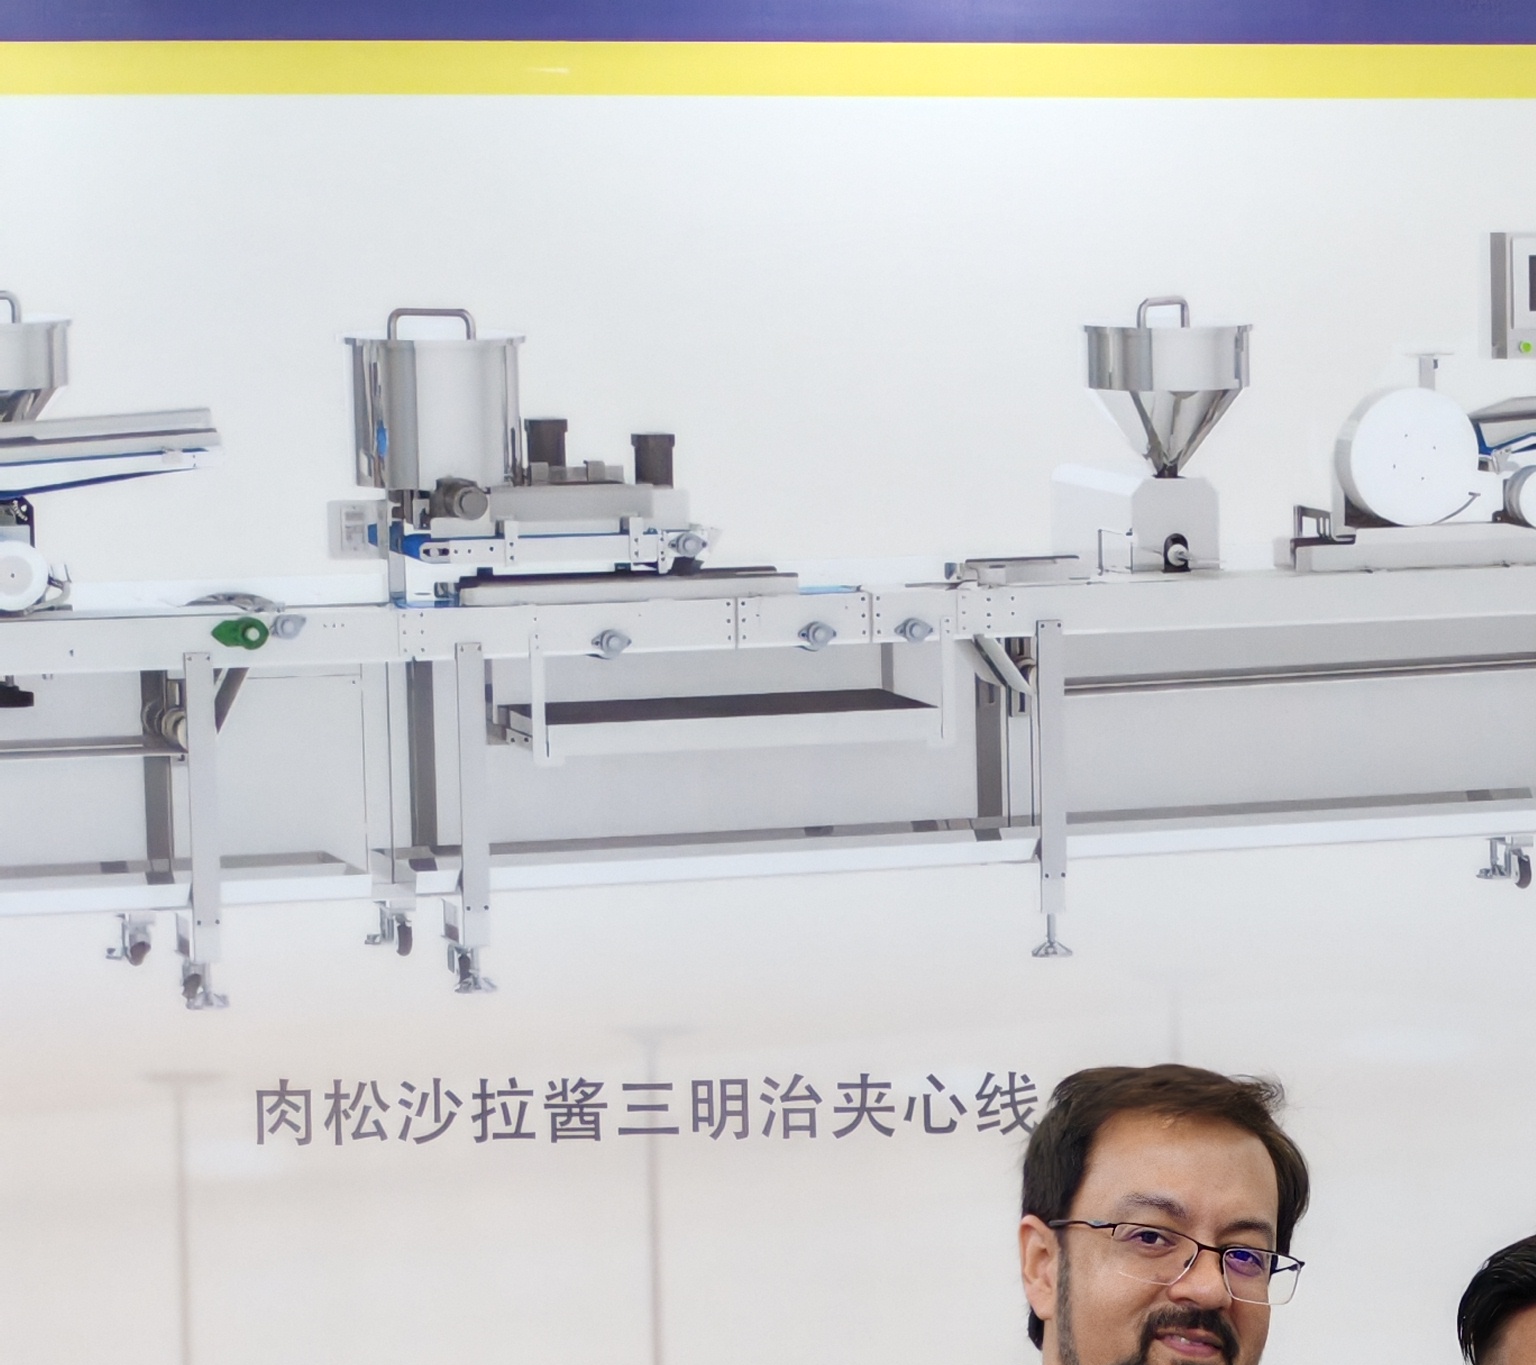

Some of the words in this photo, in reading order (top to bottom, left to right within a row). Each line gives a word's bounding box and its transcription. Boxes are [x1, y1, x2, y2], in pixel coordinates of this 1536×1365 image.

[255, 1072, 1040, 1146] 肉松沙拉酱三明治夹心线
